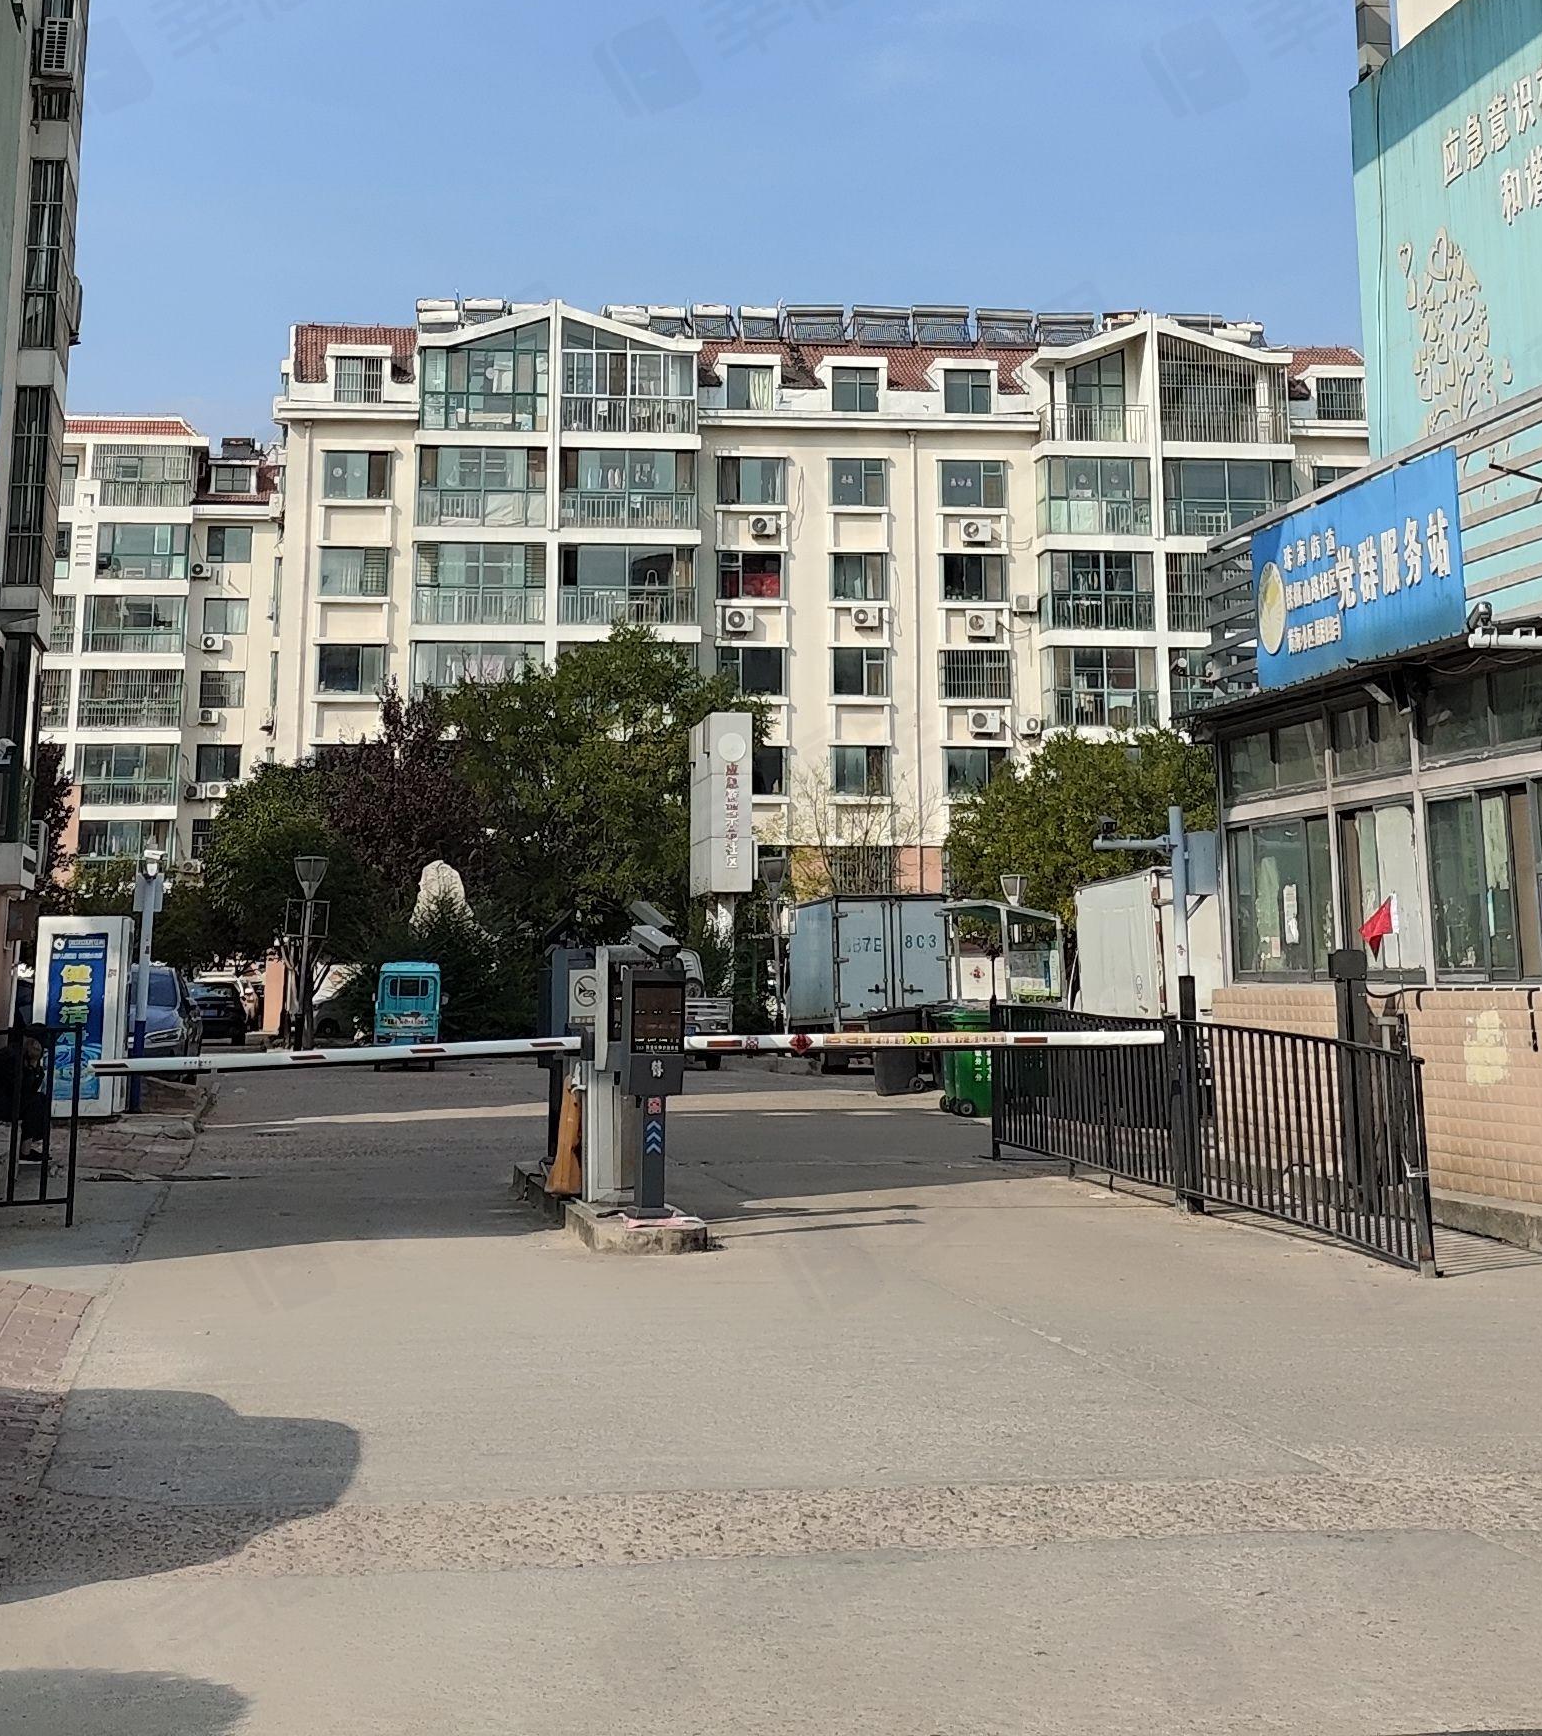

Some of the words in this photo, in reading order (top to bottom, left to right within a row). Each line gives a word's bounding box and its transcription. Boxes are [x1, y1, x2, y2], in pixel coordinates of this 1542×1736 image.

[1336, 508, 1452, 611] 党群服务站
[905, 934, 937, 949] 8C3
[908, 1036, 929, 1045] 入口
